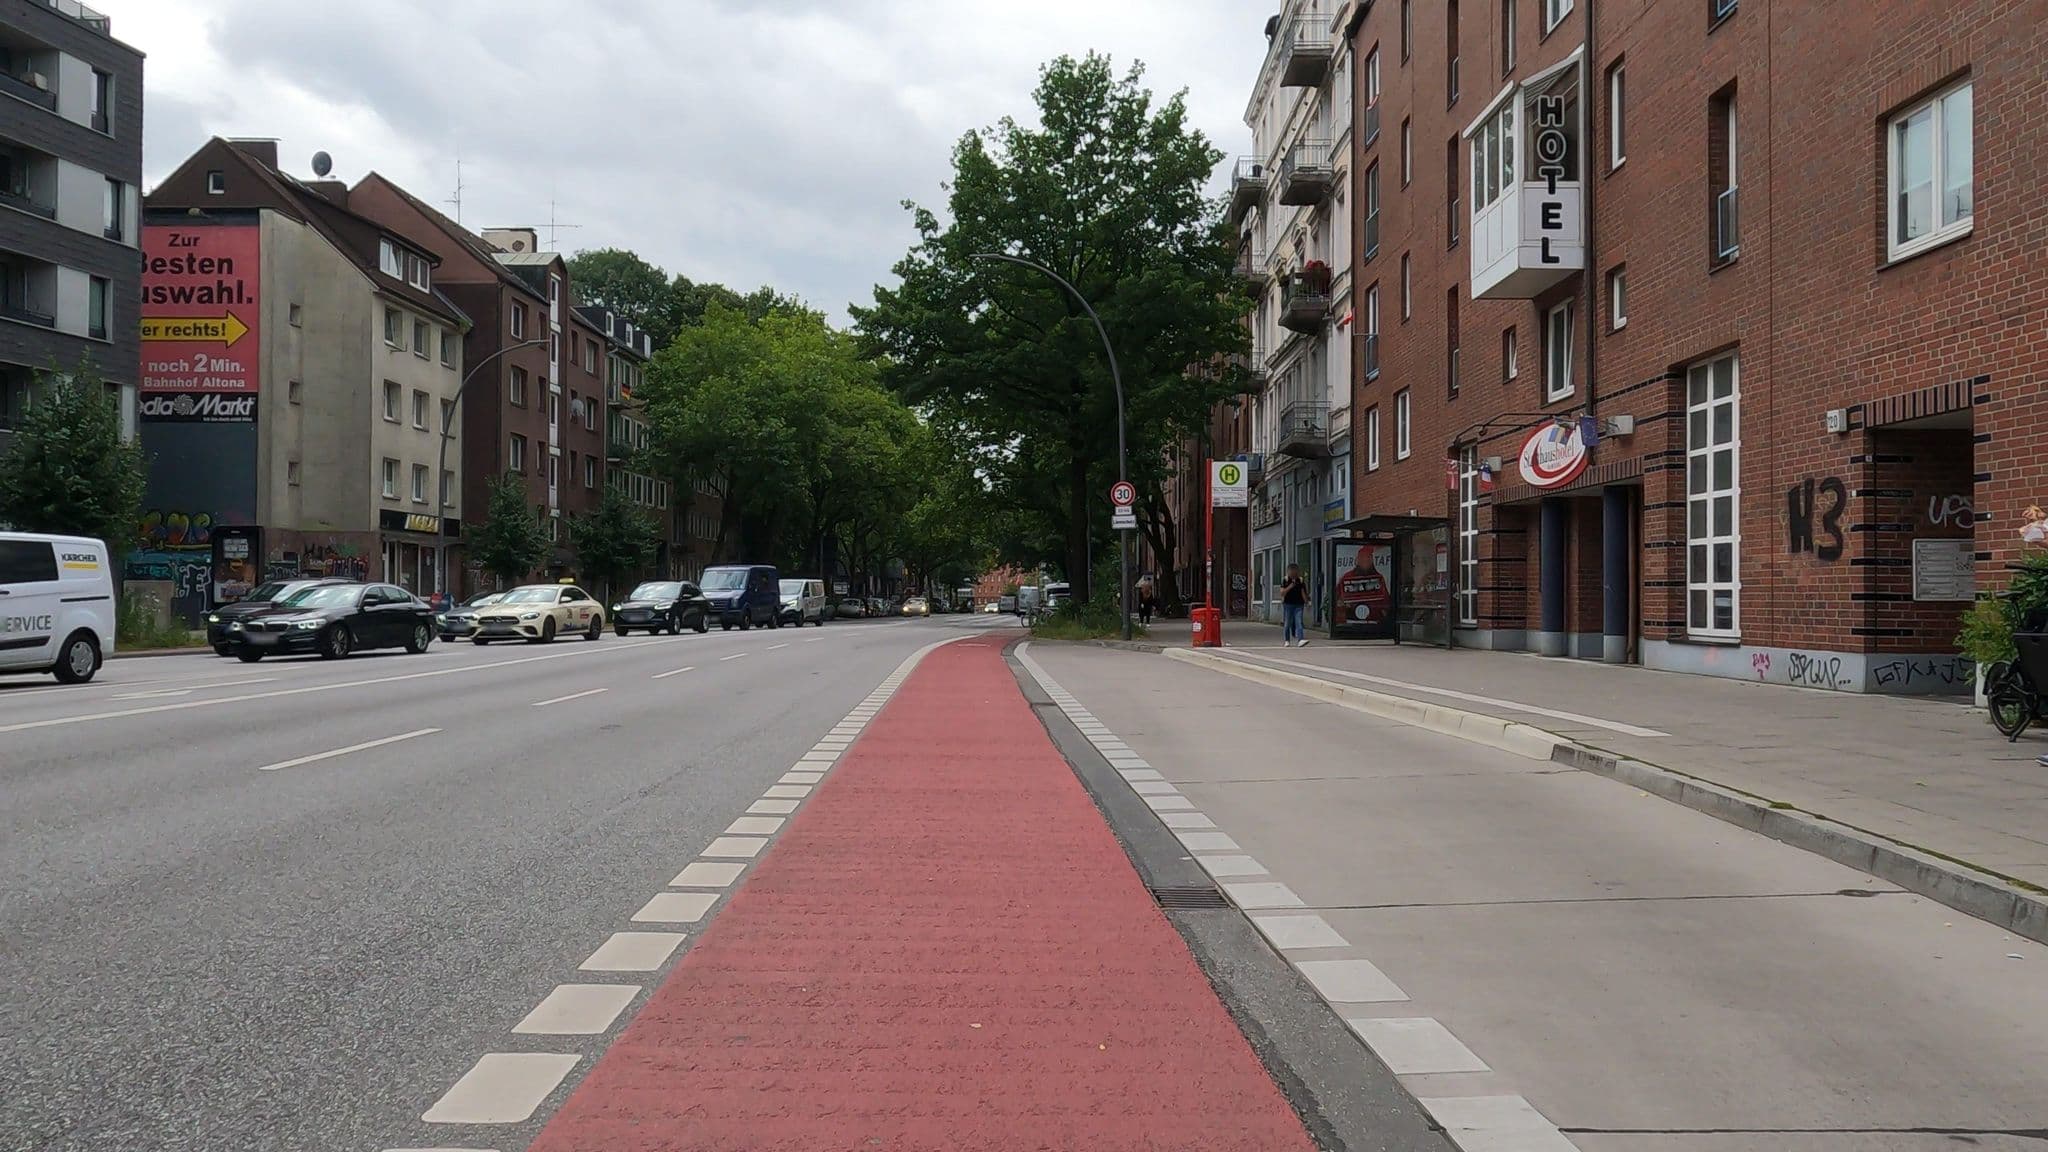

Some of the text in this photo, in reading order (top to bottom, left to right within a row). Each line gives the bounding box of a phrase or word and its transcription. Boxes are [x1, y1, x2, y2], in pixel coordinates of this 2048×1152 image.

[1538, 95, 1566, 264] HOTEL
[168, 233, 200, 247] Zur
[165, 323, 226, 337] rechts!
[148, 353, 246, 373] noch 2 Min.
[144, 377, 245, 388] Bahnhof Altona
[190, 394, 255, 416] Markt
[1116, 488, 1130, 500] 30
[6, 614, 52, 633] ERVICE
